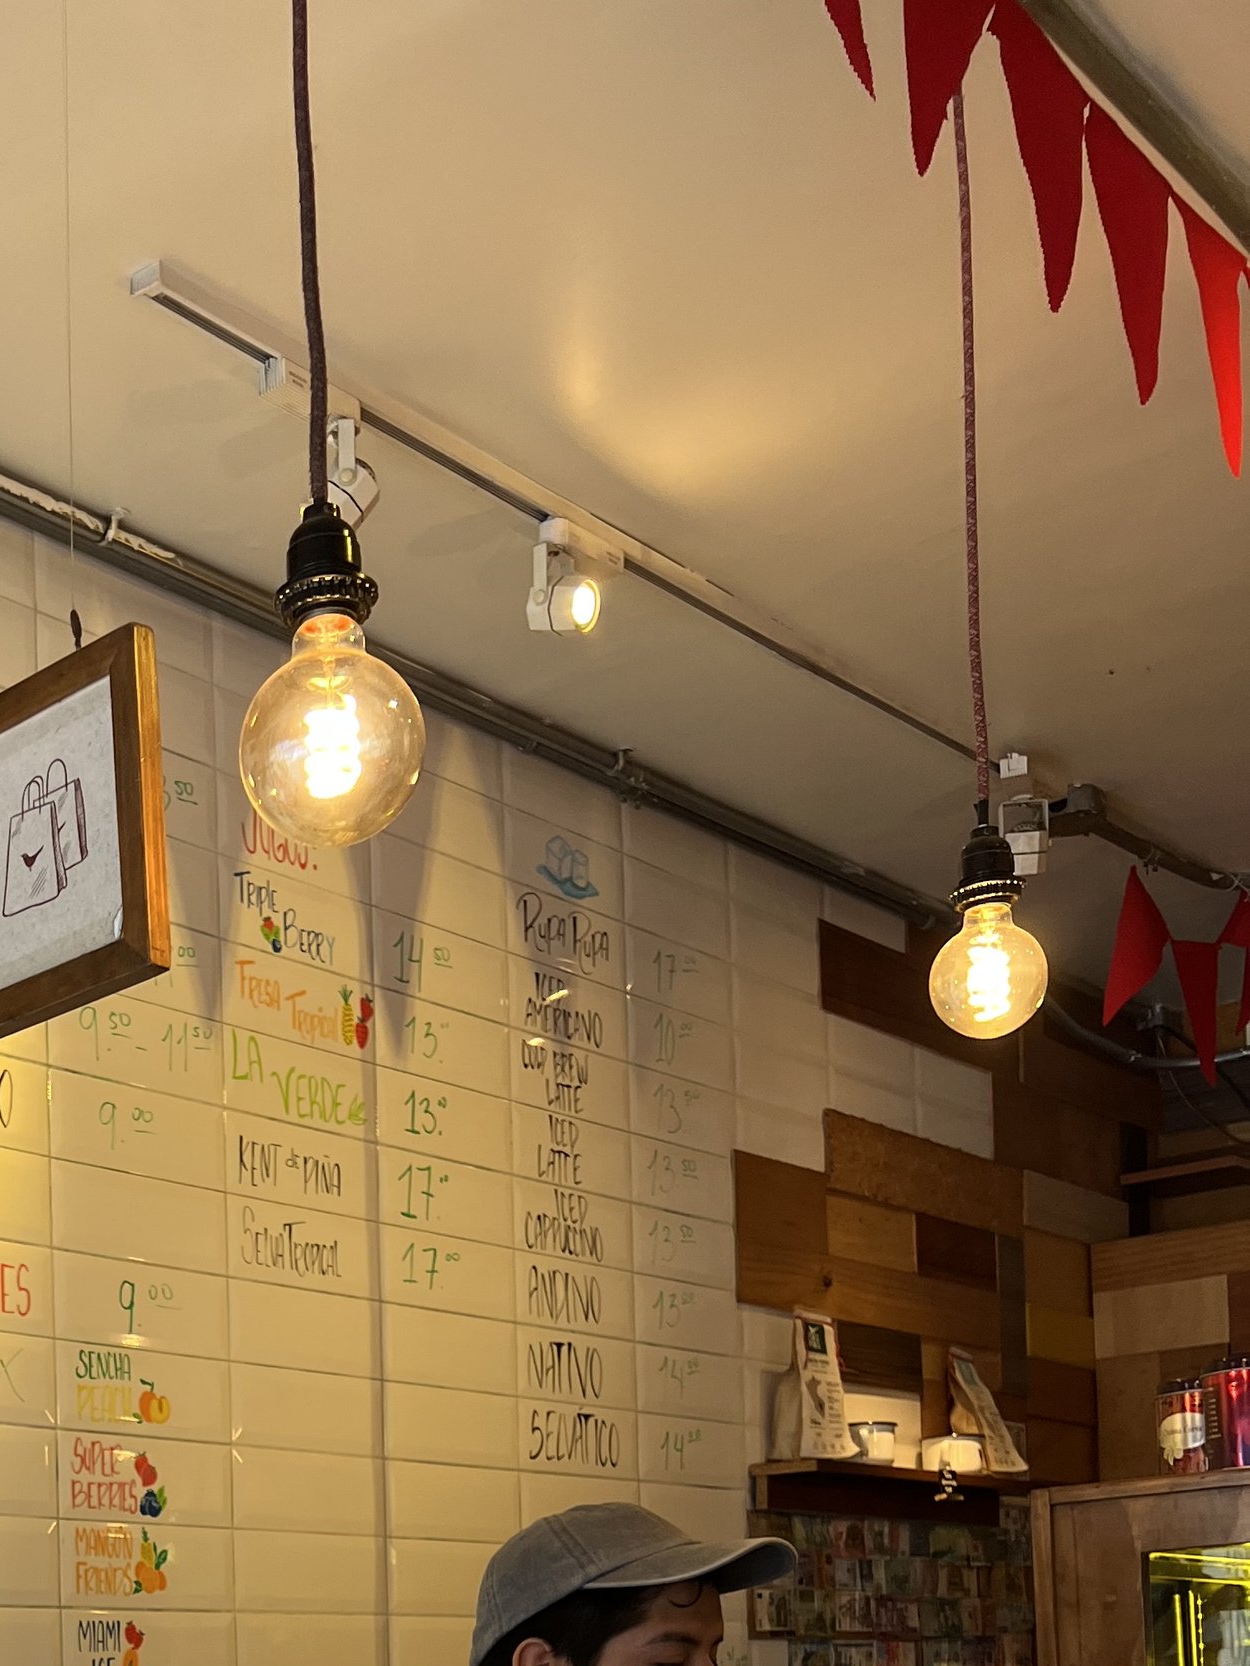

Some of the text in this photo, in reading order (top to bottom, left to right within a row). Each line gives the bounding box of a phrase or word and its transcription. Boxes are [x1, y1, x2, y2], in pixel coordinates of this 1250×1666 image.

[283, 908, 336, 966] BERRY
[524, 996, 604, 1049] AMERICANO
[231, 1028, 347, 1126] LA VERDE
[552, 1050, 589, 1086] BREW
[545, 1077, 584, 1114] LATTE
[548, 1114, 580, 1150] ICED
[238, 1134, 283, 1187] KENT
[302, 1154, 342, 1197] PIÑA
[537, 1143, 583, 1185] LATTE
[553, 1188, 589, 1228] ICED
[524, 1211, 604, 1263] CAPPUCCINO
[528, 1264, 602, 1324] ANDINO
[75, 1349, 132, 1382] SENCHA
[527, 1341, 603, 1400] NATIVO
[77, 1384, 133, 1425] PEACH
[71, 1437, 124, 1477] SUPER
[71, 1479, 139, 1515] BERRIES
[75, 1561, 133, 1597] FRIENDS
[78, 1620, 121, 1653] MIAMI
